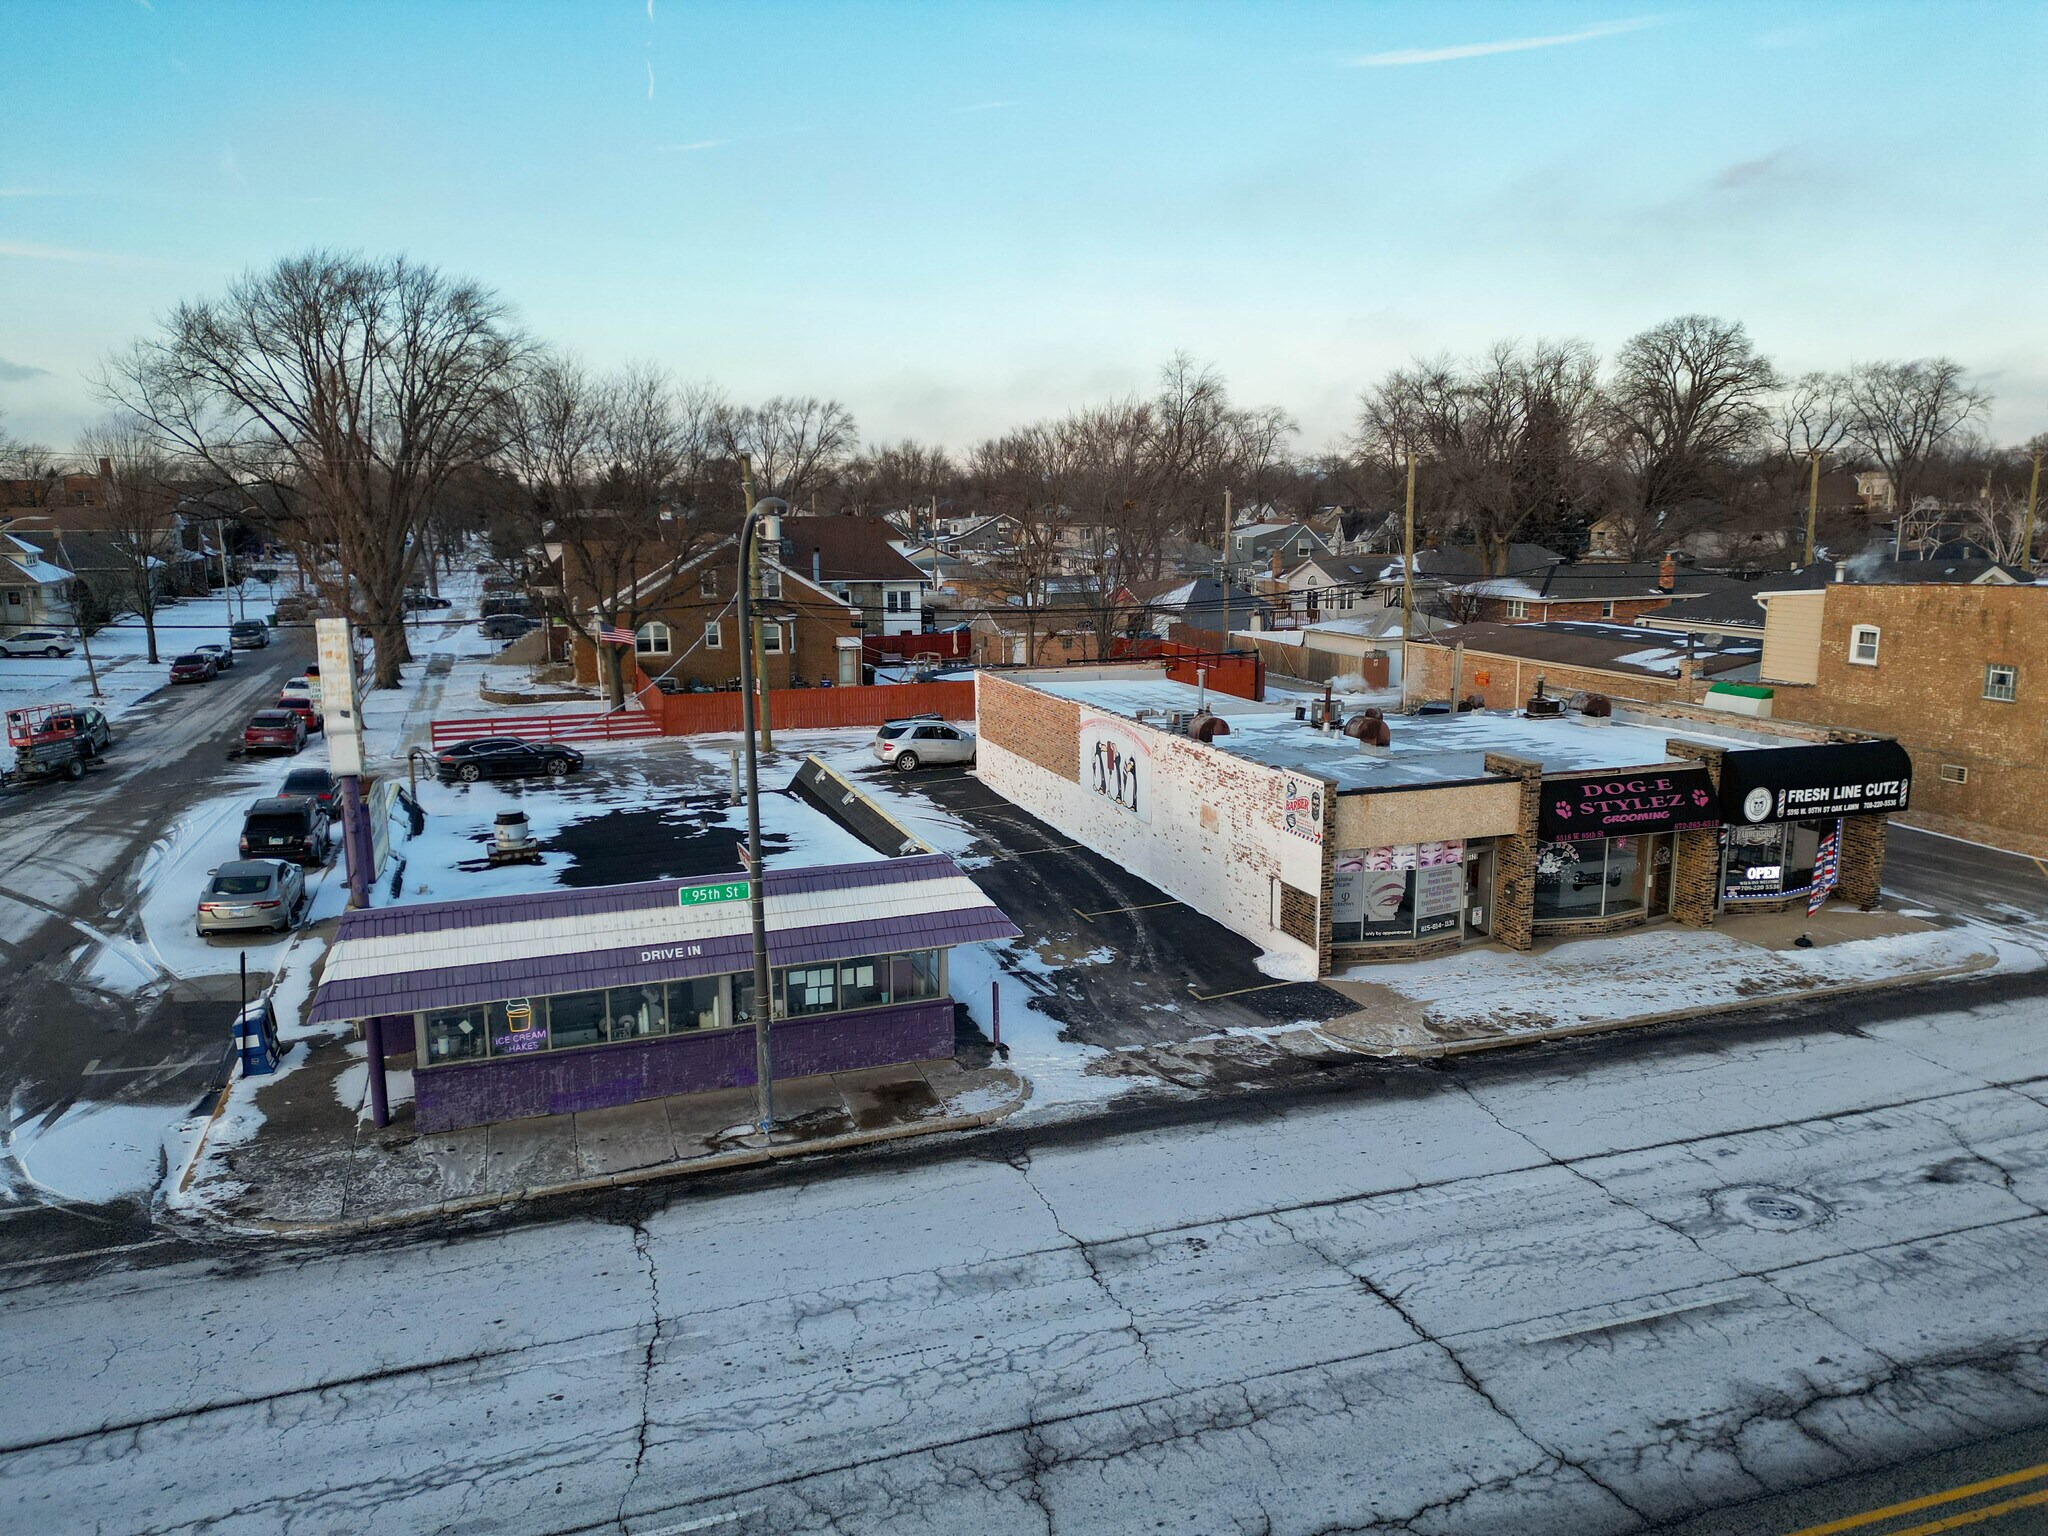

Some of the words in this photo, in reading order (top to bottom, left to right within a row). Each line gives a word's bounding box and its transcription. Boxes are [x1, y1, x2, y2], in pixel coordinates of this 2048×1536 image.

[1581, 778, 1673, 797] DOG-E
[1788, 787, 1830, 803] FRESH
[1833, 785, 1863, 800] LINE
[1865, 781, 1899, 797] CUTZ
[1580, 794, 1685, 815] STYLEZ
[1823, 805, 1831, 813] ST
[1831, 804, 1843, 813] OAK
[1843, 803, 1860, 812] LAWN
[1602, 811, 1670, 824] GROOMING
[1747, 866, 1781, 880] OPEN
[692, 888, 720, 901] 95th
[725, 886, 739, 899] St
[641, 947, 684, 962] DRIVE
[687, 945, 701, 956] IN
[495, 1035, 511, 1046] ICE
[512, 1030, 547, 1043] CREAM
